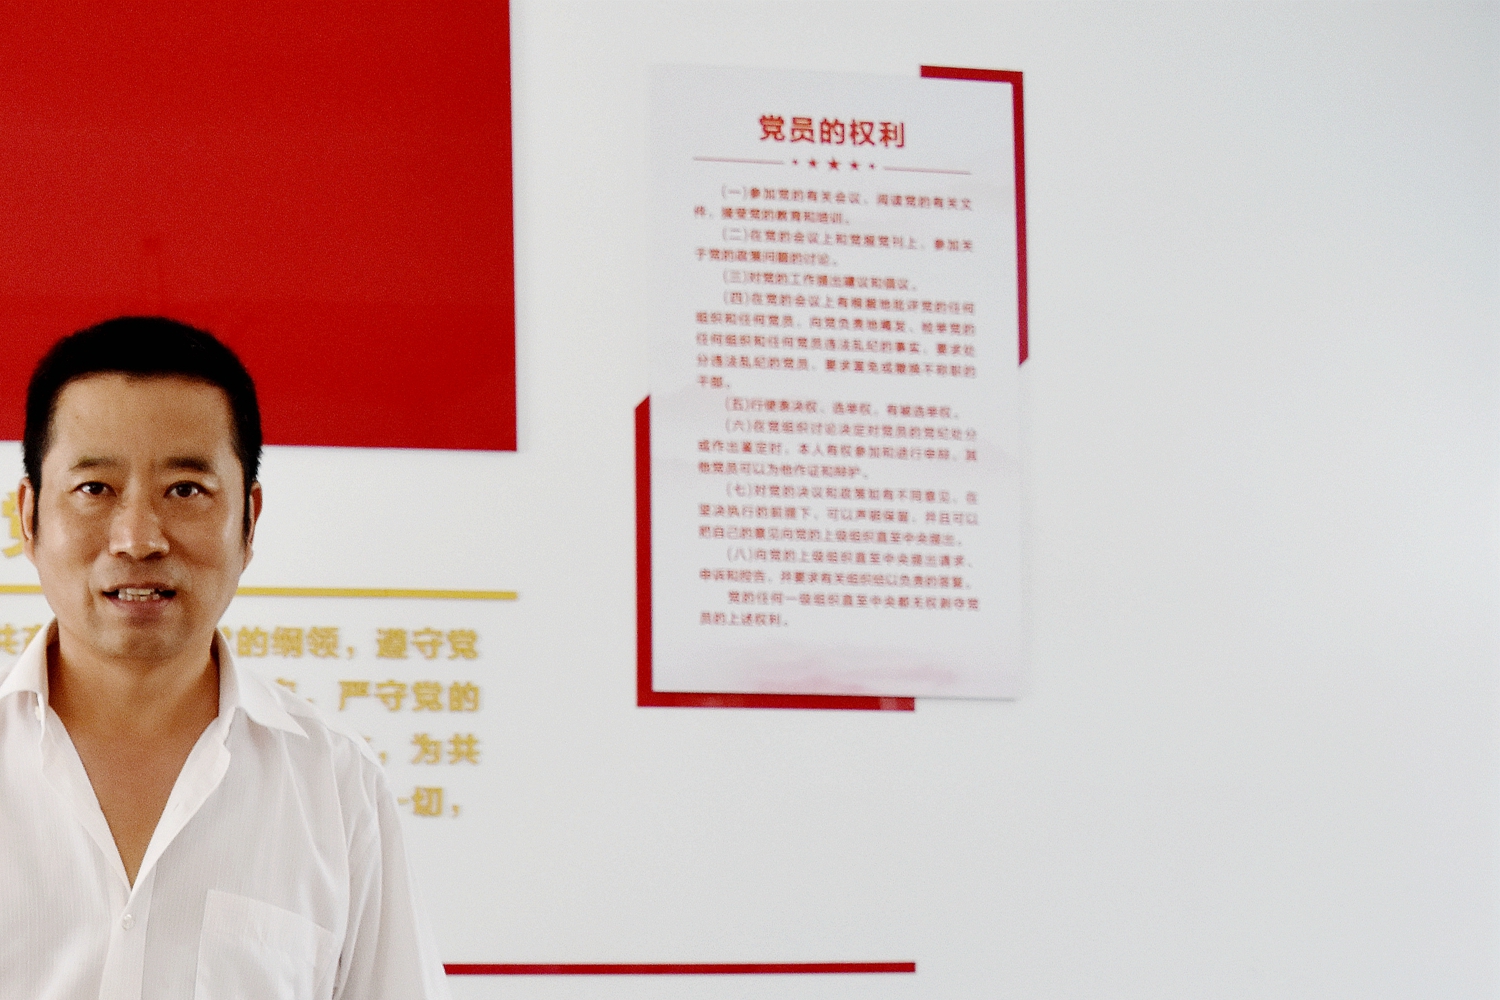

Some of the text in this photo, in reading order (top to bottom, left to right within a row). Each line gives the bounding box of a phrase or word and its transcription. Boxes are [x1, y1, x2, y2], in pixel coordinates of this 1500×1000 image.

[759, 114, 906, 149] 党员的权利
[220, 625, 480, 660] 的纲领，遵守党
